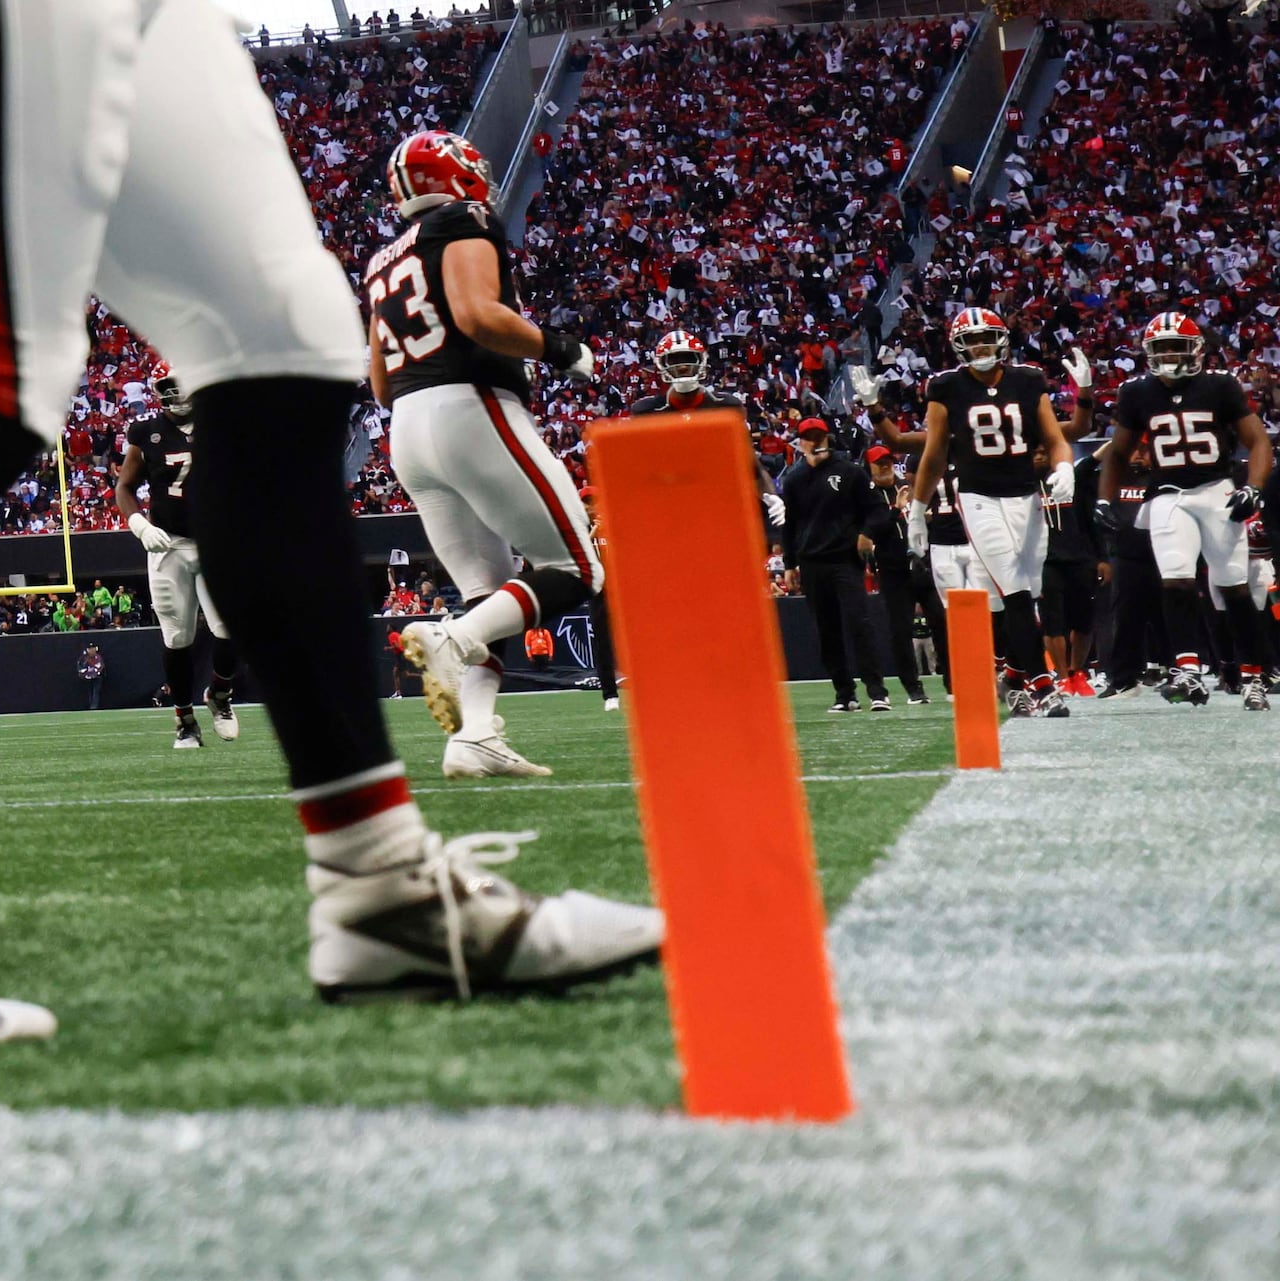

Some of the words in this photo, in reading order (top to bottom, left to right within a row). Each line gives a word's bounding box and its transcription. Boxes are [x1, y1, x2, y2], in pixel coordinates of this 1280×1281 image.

[657, 124, 667, 134] 21
[967, 403, 1028, 457] 81
[1150, 411, 1221, 467] 25
[15, 612, 29, 626] 21
